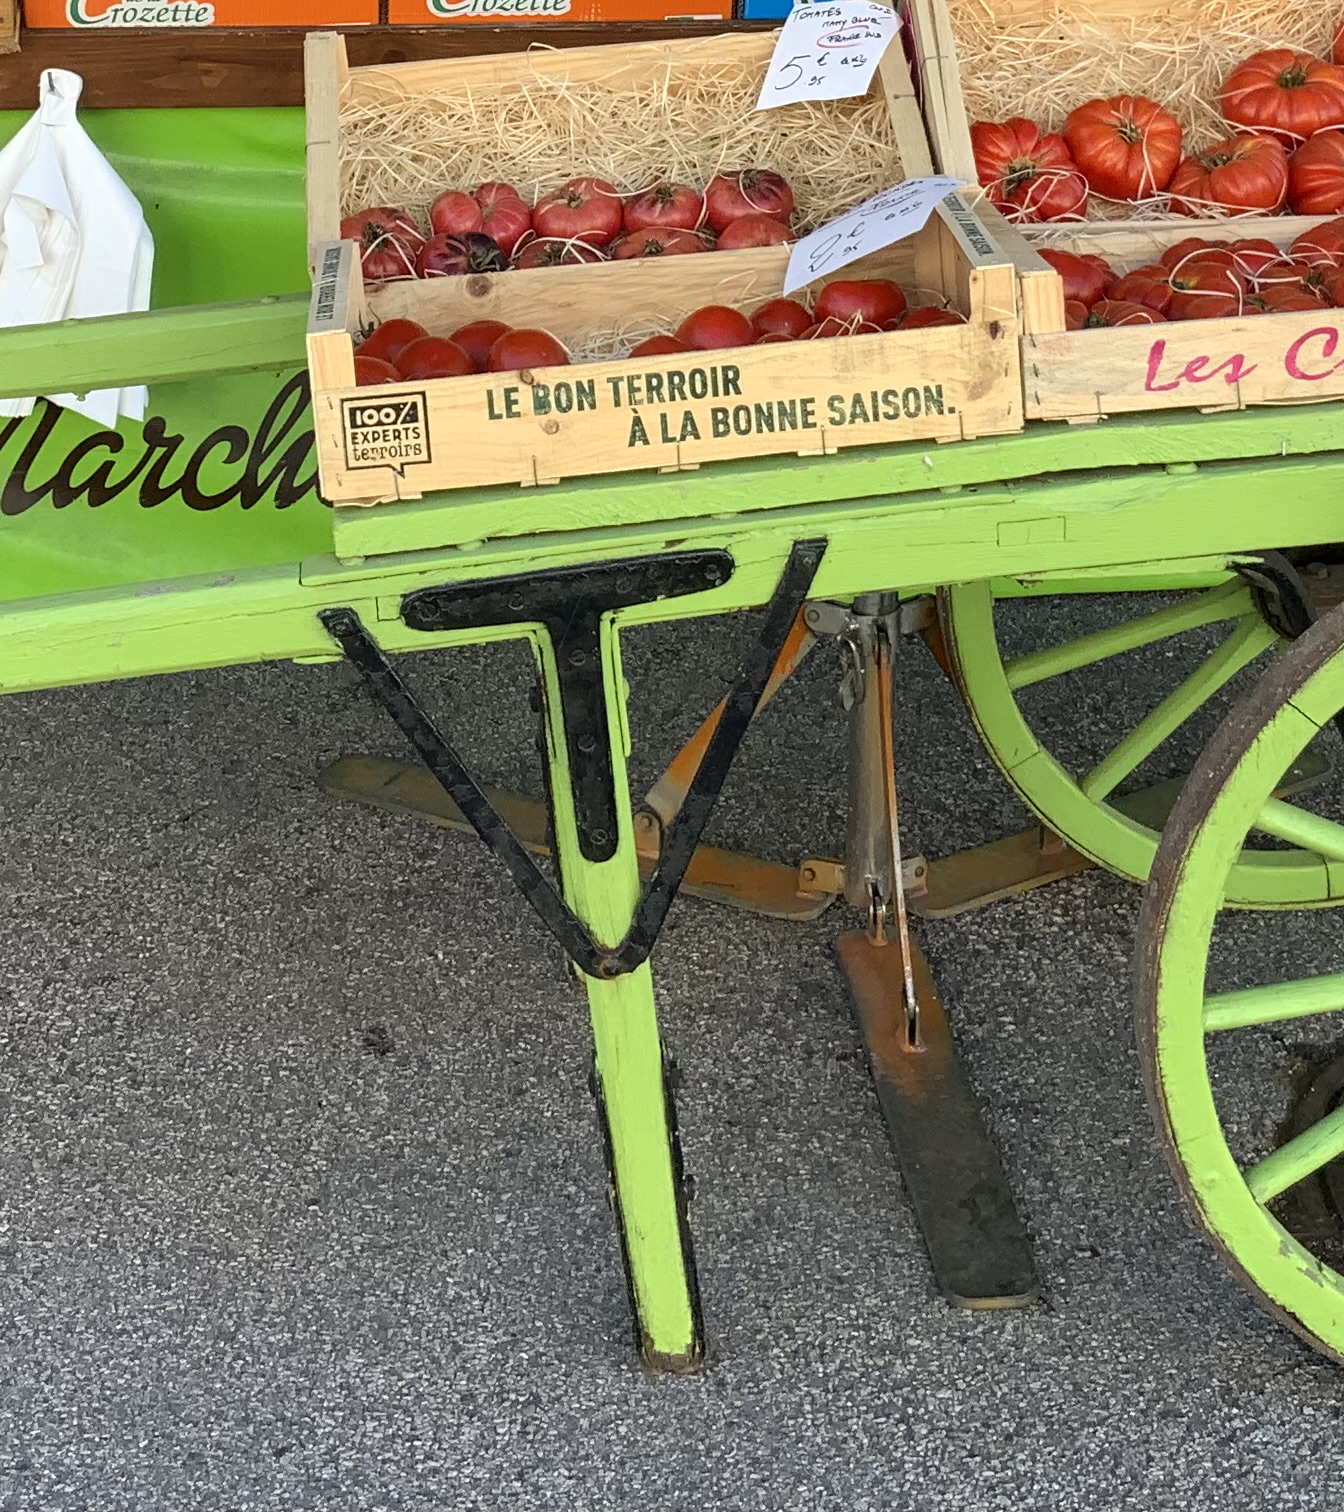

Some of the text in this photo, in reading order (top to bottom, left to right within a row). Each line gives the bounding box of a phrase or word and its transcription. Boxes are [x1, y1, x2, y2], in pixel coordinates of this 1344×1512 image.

[793, 6, 842, 23] TOMATES
[775, 54, 812, 90] 5
[817, 52, 830, 67] €
[846, 221, 866, 239] €
[1144, 339, 1258, 394] Les
[485, 364, 742, 421] LE BON TERROIR
[355, 401, 412, 426] 100%
[628, 383, 957, 448] À LA BONNE SAISON.
[350, 426, 422, 446] EXPERTS
[352, 441, 423, 462] terroirs
